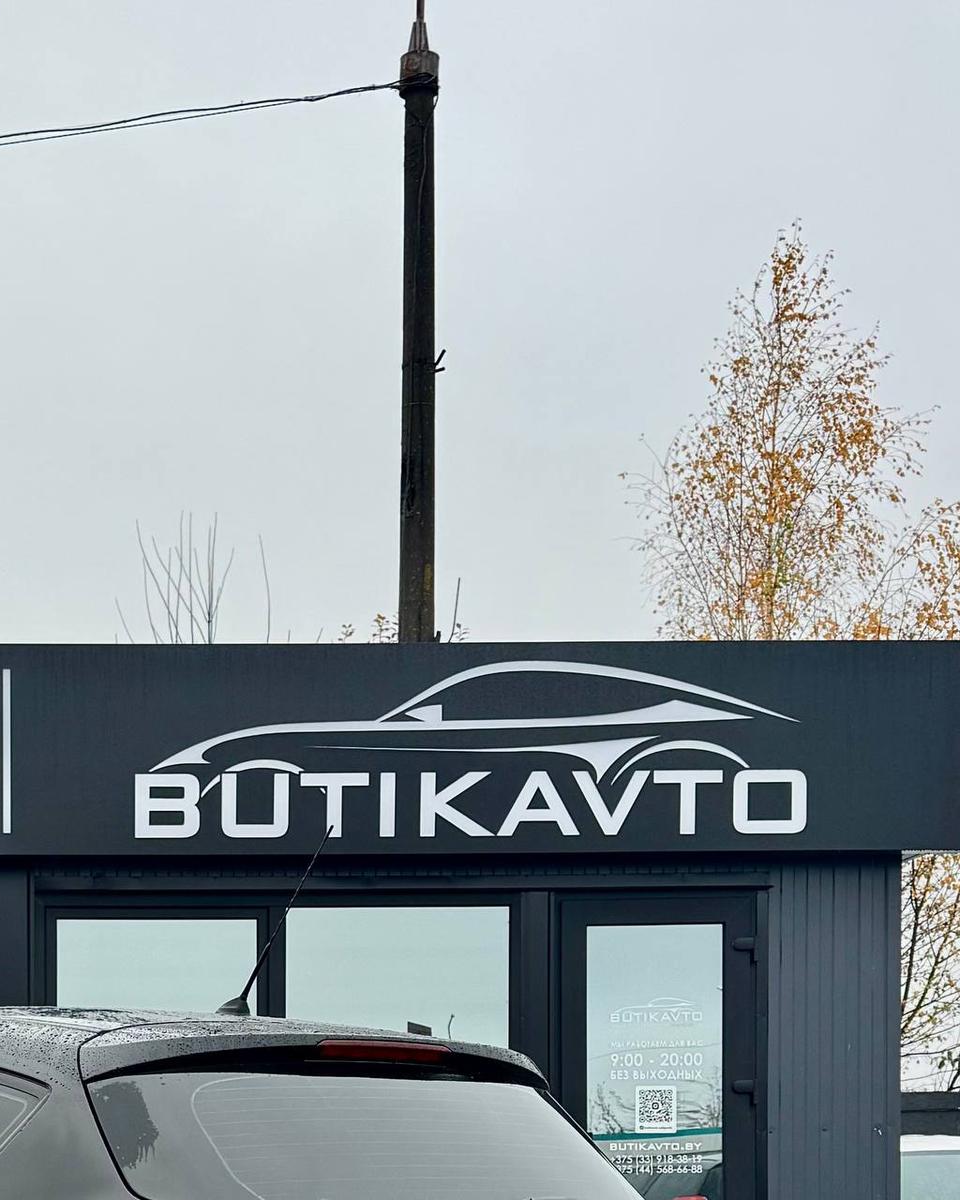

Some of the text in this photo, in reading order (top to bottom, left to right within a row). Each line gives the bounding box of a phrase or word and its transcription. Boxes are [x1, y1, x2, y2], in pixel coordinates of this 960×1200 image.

[134, 769, 808, 839] BUTIKAVTO
[610, 1011, 703, 1023] BUTIKAVTO
[610, 1053, 643, 1067] 9:00
[660, 1053, 703, 1067] 20:00
[610, 1070, 703, 1080] БЕЗ ВЫХОДНЫХ
[609, 1142, 703, 1151] BUTIKAVTO.BY
[636, 1154, 653, 1166] (33)
[656, 1154, 703, 1164] 918-38-19
[636, 1164, 653, 1176] (44)
[656, 1164, 703, 1174] 568-66-88
